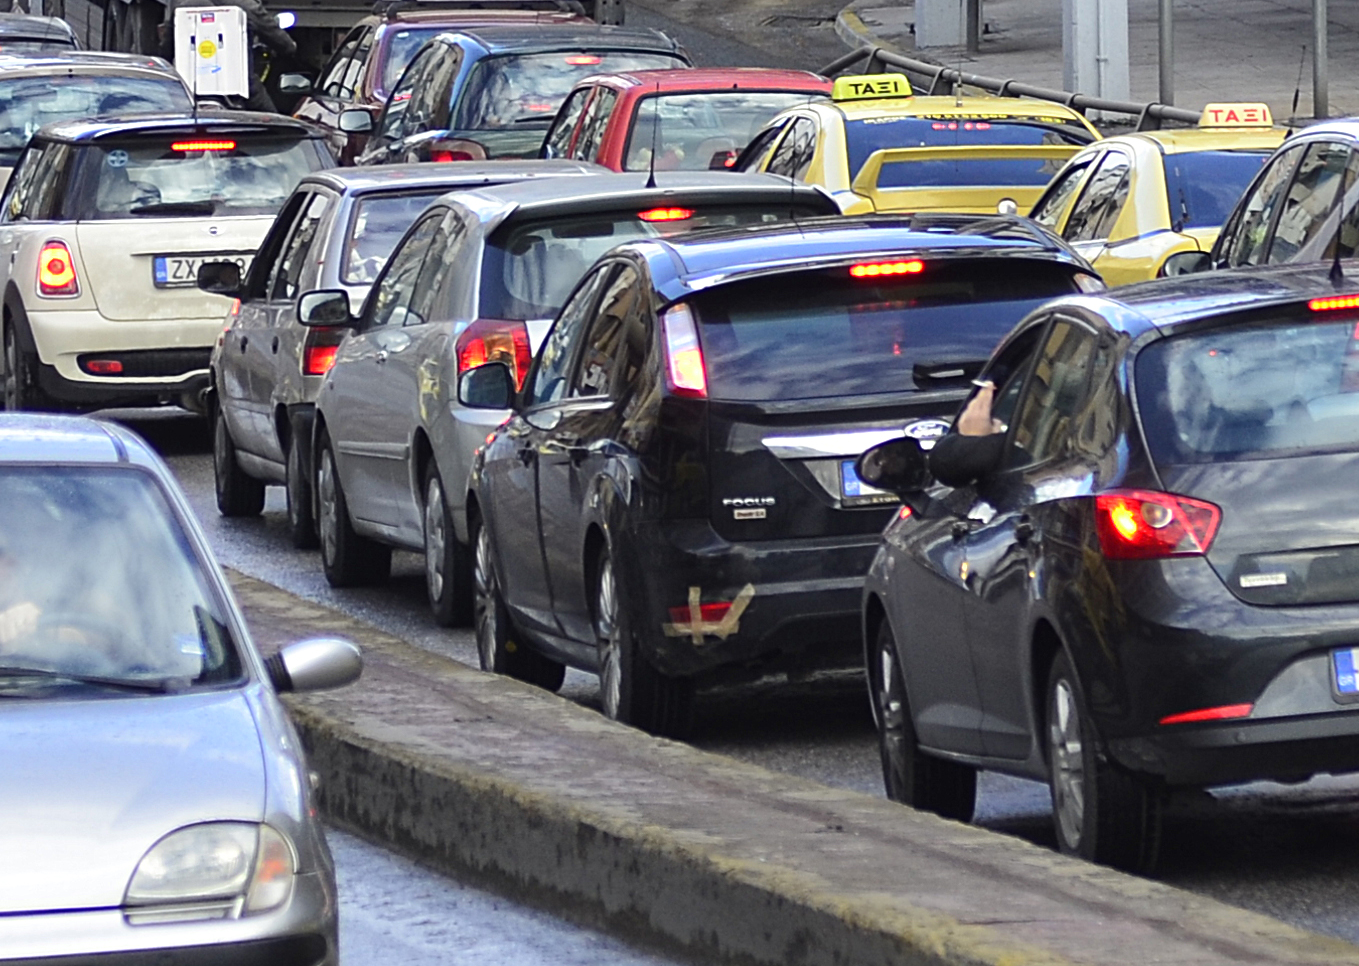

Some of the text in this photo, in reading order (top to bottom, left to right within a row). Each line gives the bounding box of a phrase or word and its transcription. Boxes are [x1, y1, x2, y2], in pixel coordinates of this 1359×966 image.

[849, 81, 899, 95] ΤΑΞΙ
[1208, 108, 1267, 122] ΤΑΞΙ
[722, 496, 776, 506] FOCUS
